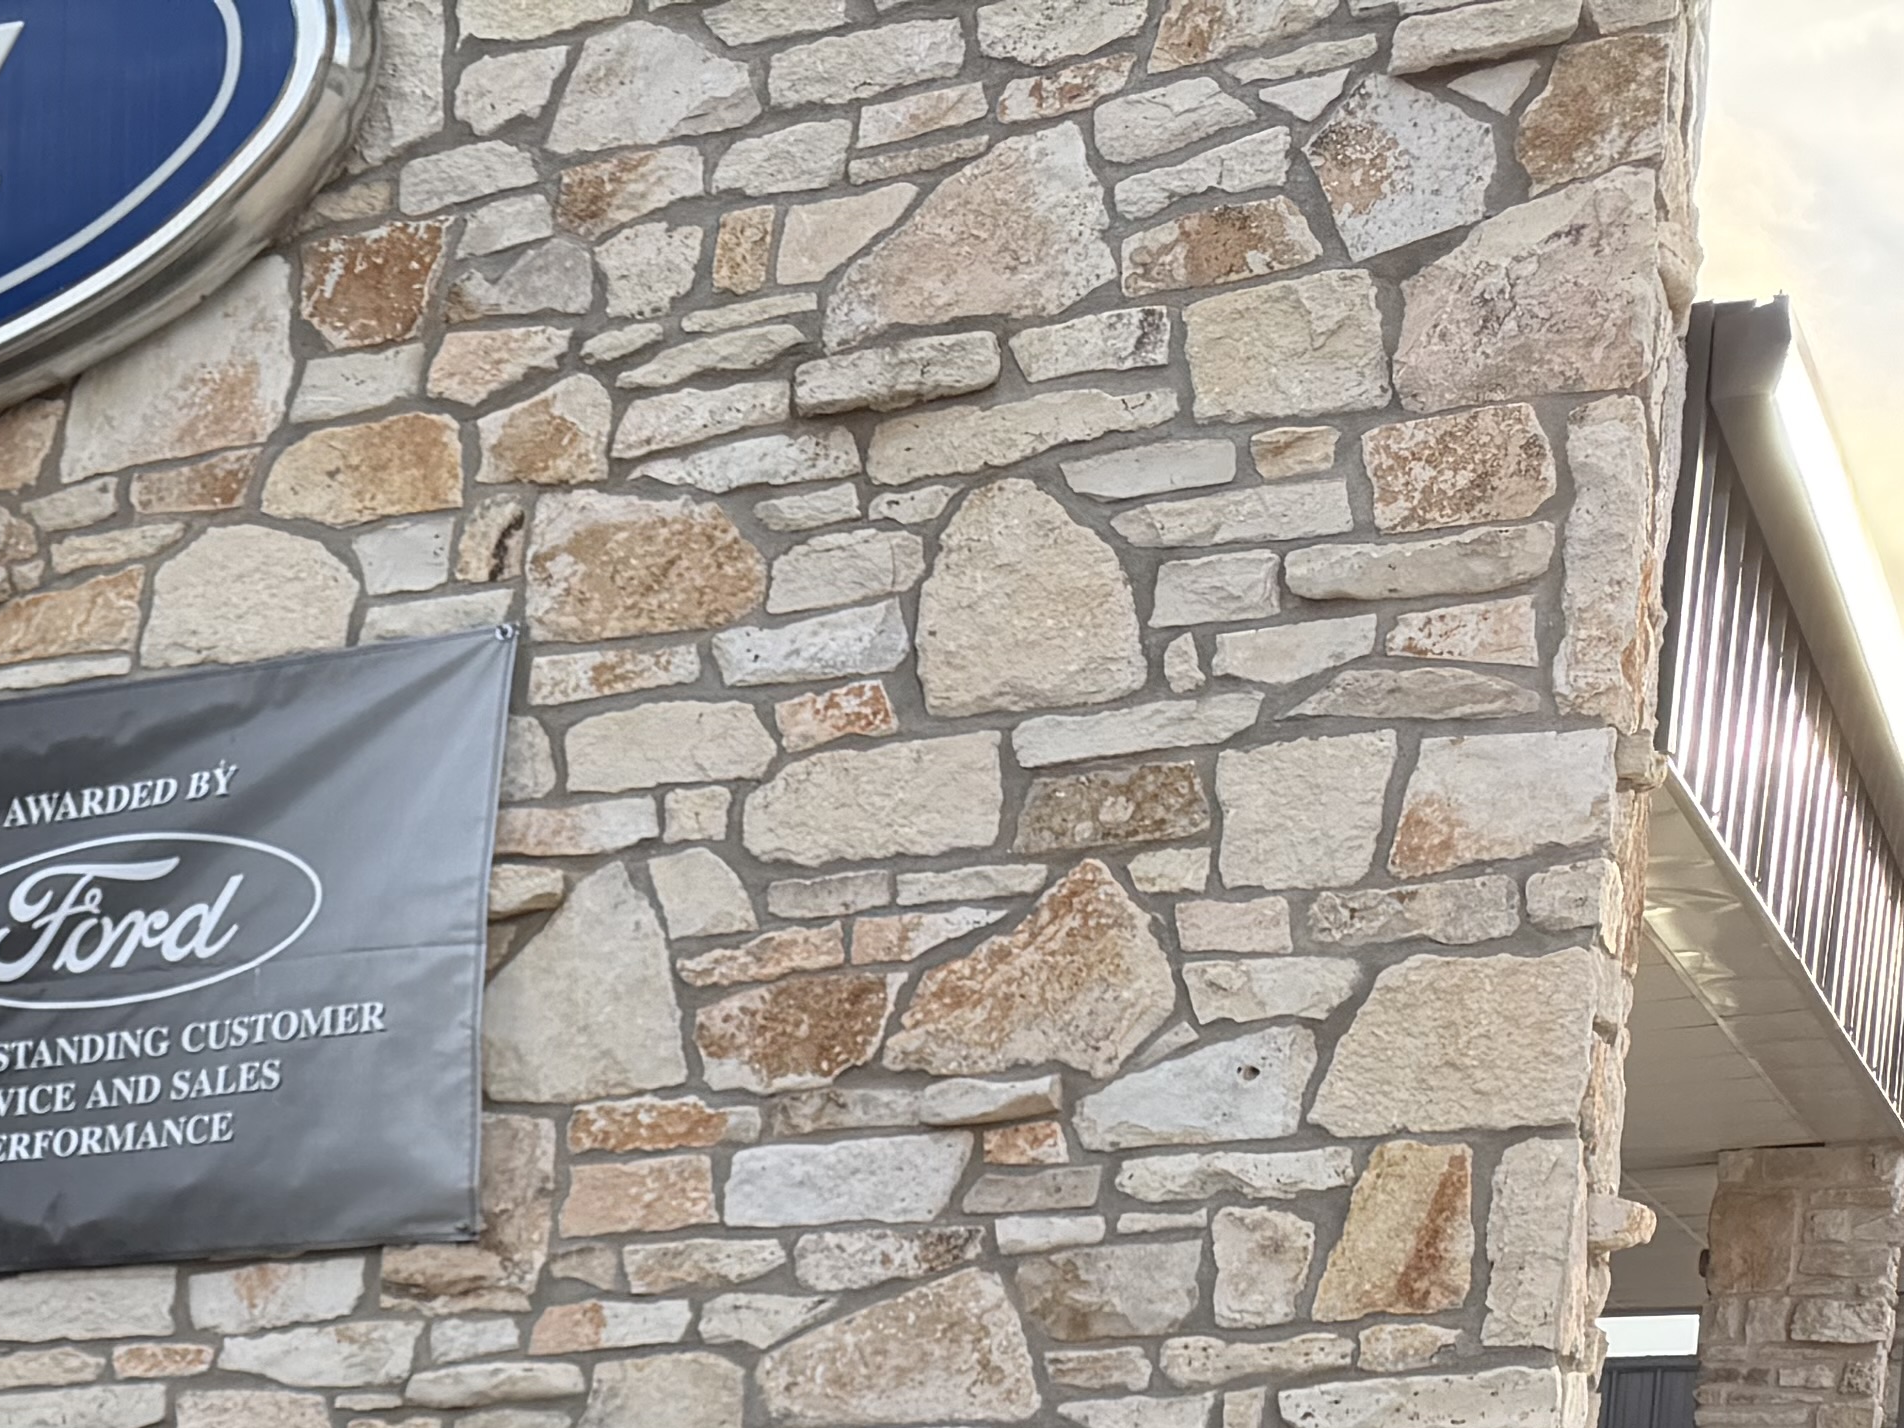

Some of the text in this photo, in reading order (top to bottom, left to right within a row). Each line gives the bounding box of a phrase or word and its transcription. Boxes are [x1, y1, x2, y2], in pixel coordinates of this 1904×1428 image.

[2, 763, 239, 828] AWARDED BY
[180, 1001, 387, 1054] CUSTOMER
[85, 1073, 162, 1110] AND
[169, 1058, 283, 1100] SALES
